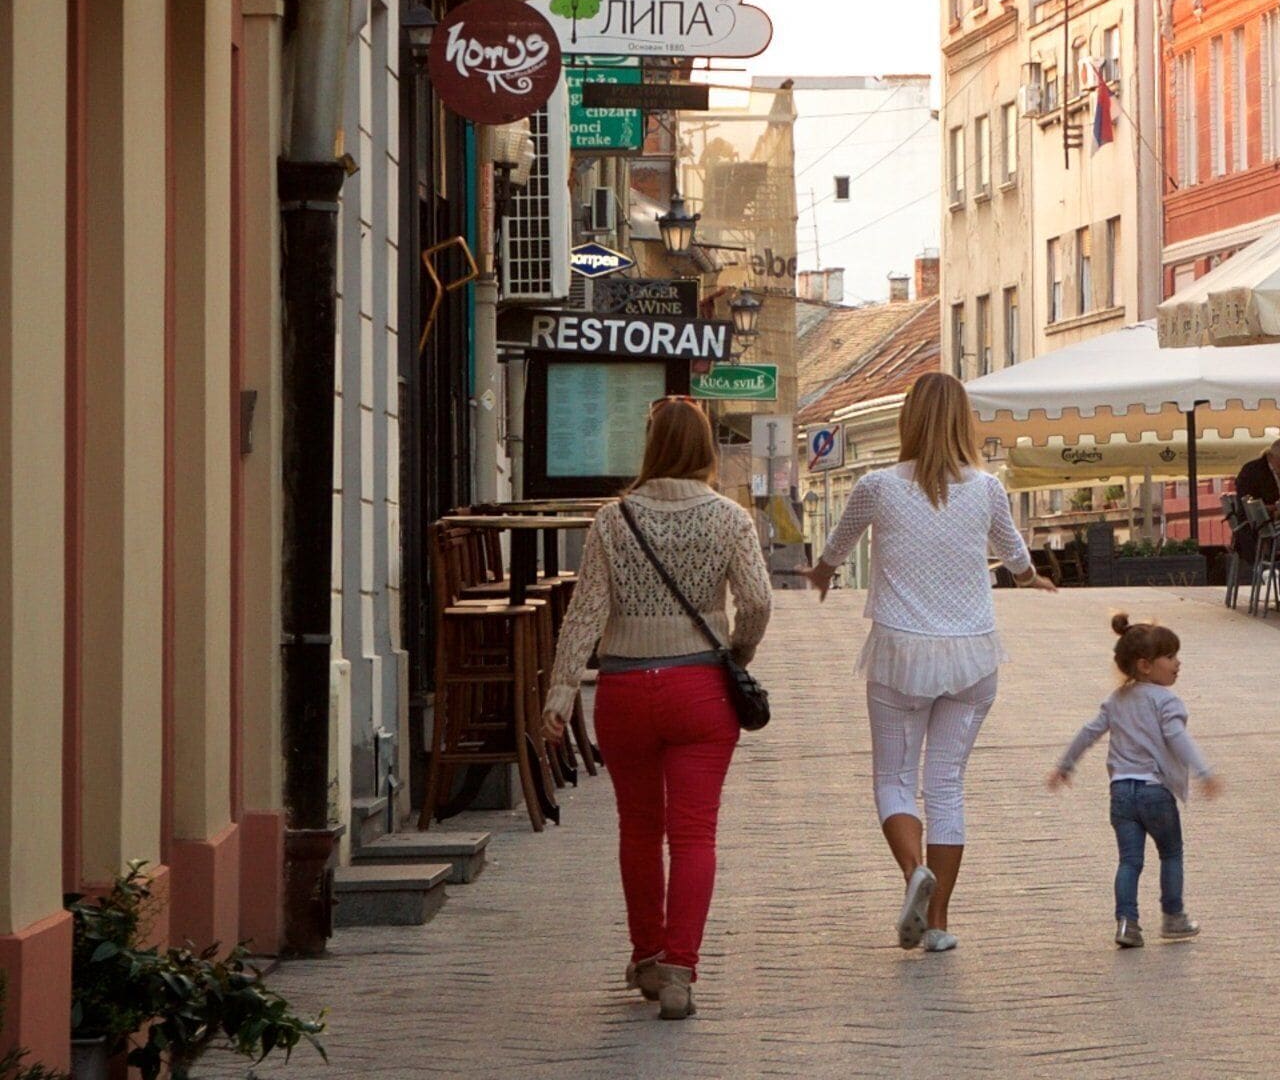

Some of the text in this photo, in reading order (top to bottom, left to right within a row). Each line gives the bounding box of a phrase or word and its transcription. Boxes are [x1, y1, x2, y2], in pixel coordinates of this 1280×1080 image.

[601, 0, 713, 36] ЛИПА
[571, 121, 602, 133] onci
[532, 316, 726, 358] RESTORAN
